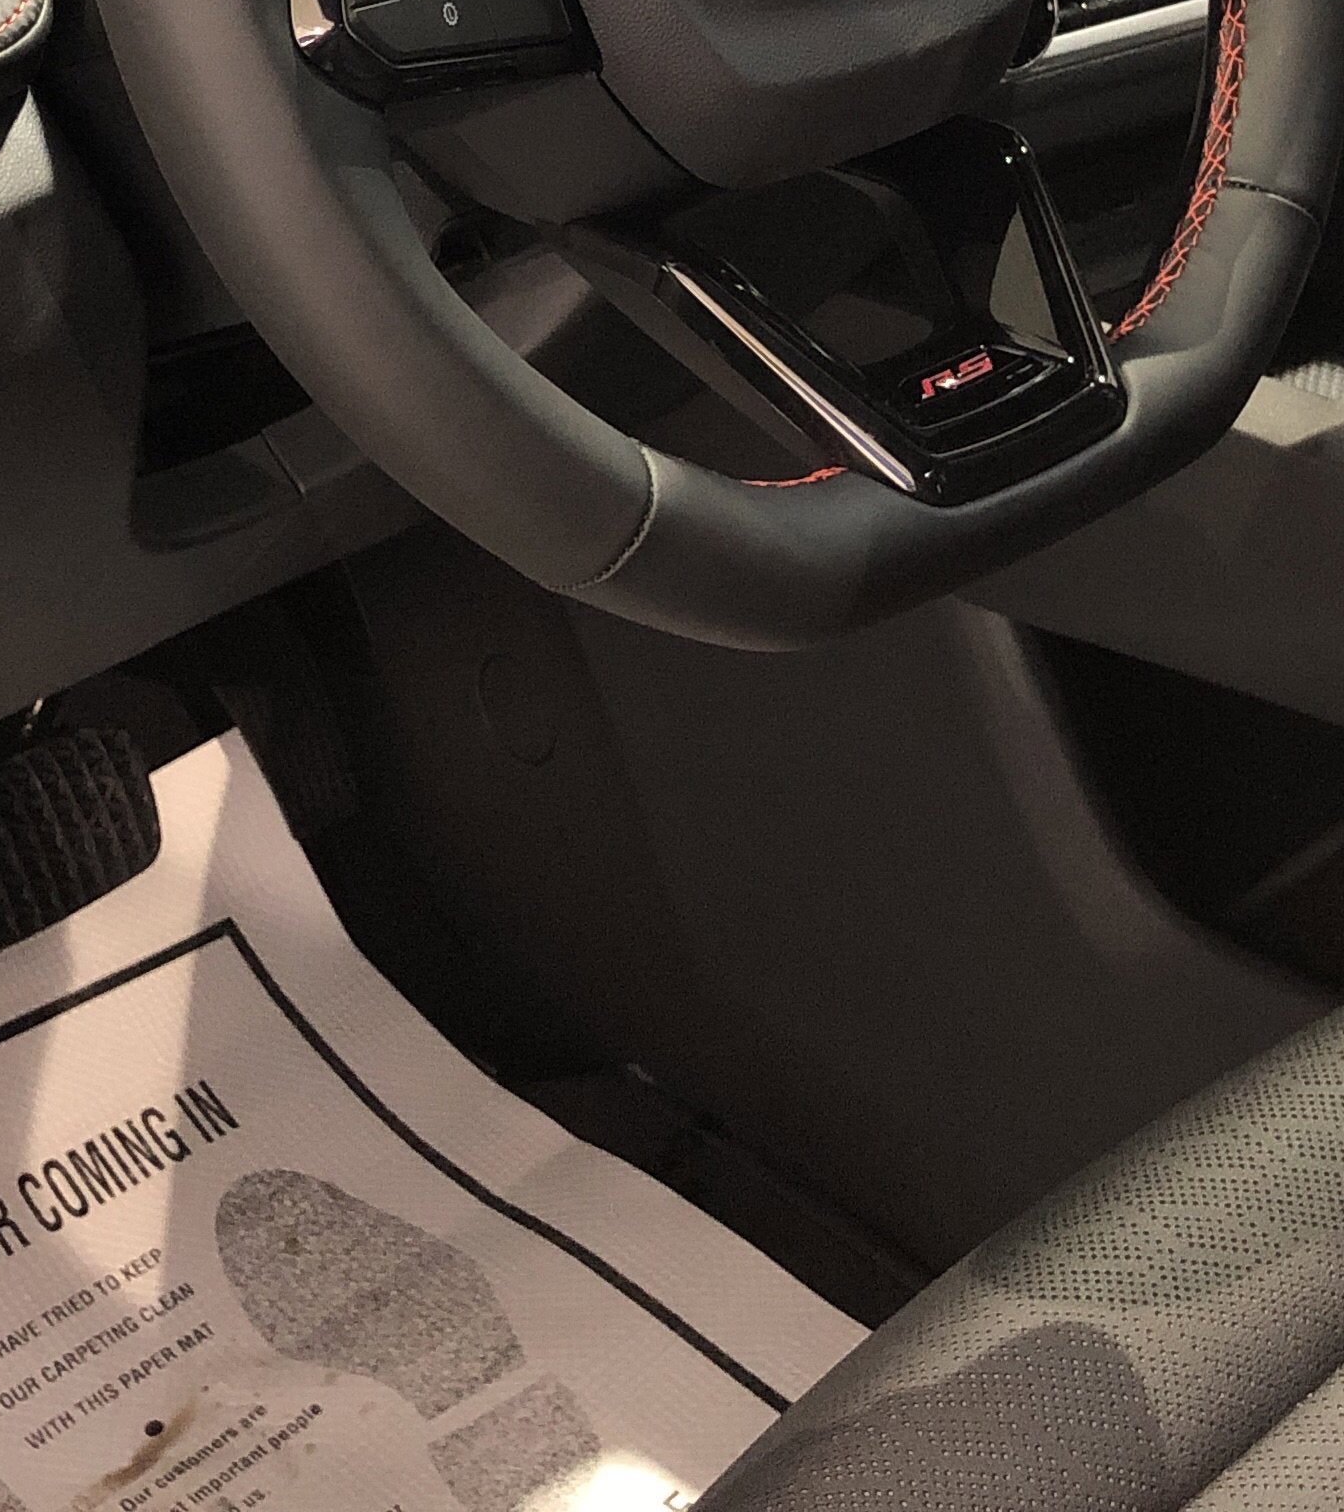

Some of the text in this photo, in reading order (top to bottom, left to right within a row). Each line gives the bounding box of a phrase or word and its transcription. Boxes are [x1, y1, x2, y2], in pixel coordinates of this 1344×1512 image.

[17, 1106, 192, 1233] COMING
[174, 1079, 240, 1144] IN
[39, 1315, 140, 1385] CARPETING
[138, 1281, 196, 1324] CLEAN
[41, 1289, 97, 1335] TRIED
[93, 1272, 121, 1299] TO
[119, 1247, 163, 1284] KEEP
[24, 1320, 217, 1452] WITH THIS PAPER MAT
[119, 1404, 268, 1512] Our customers are
[187, 1444, 269, 1505] important
[267, 1403, 324, 1451] people
